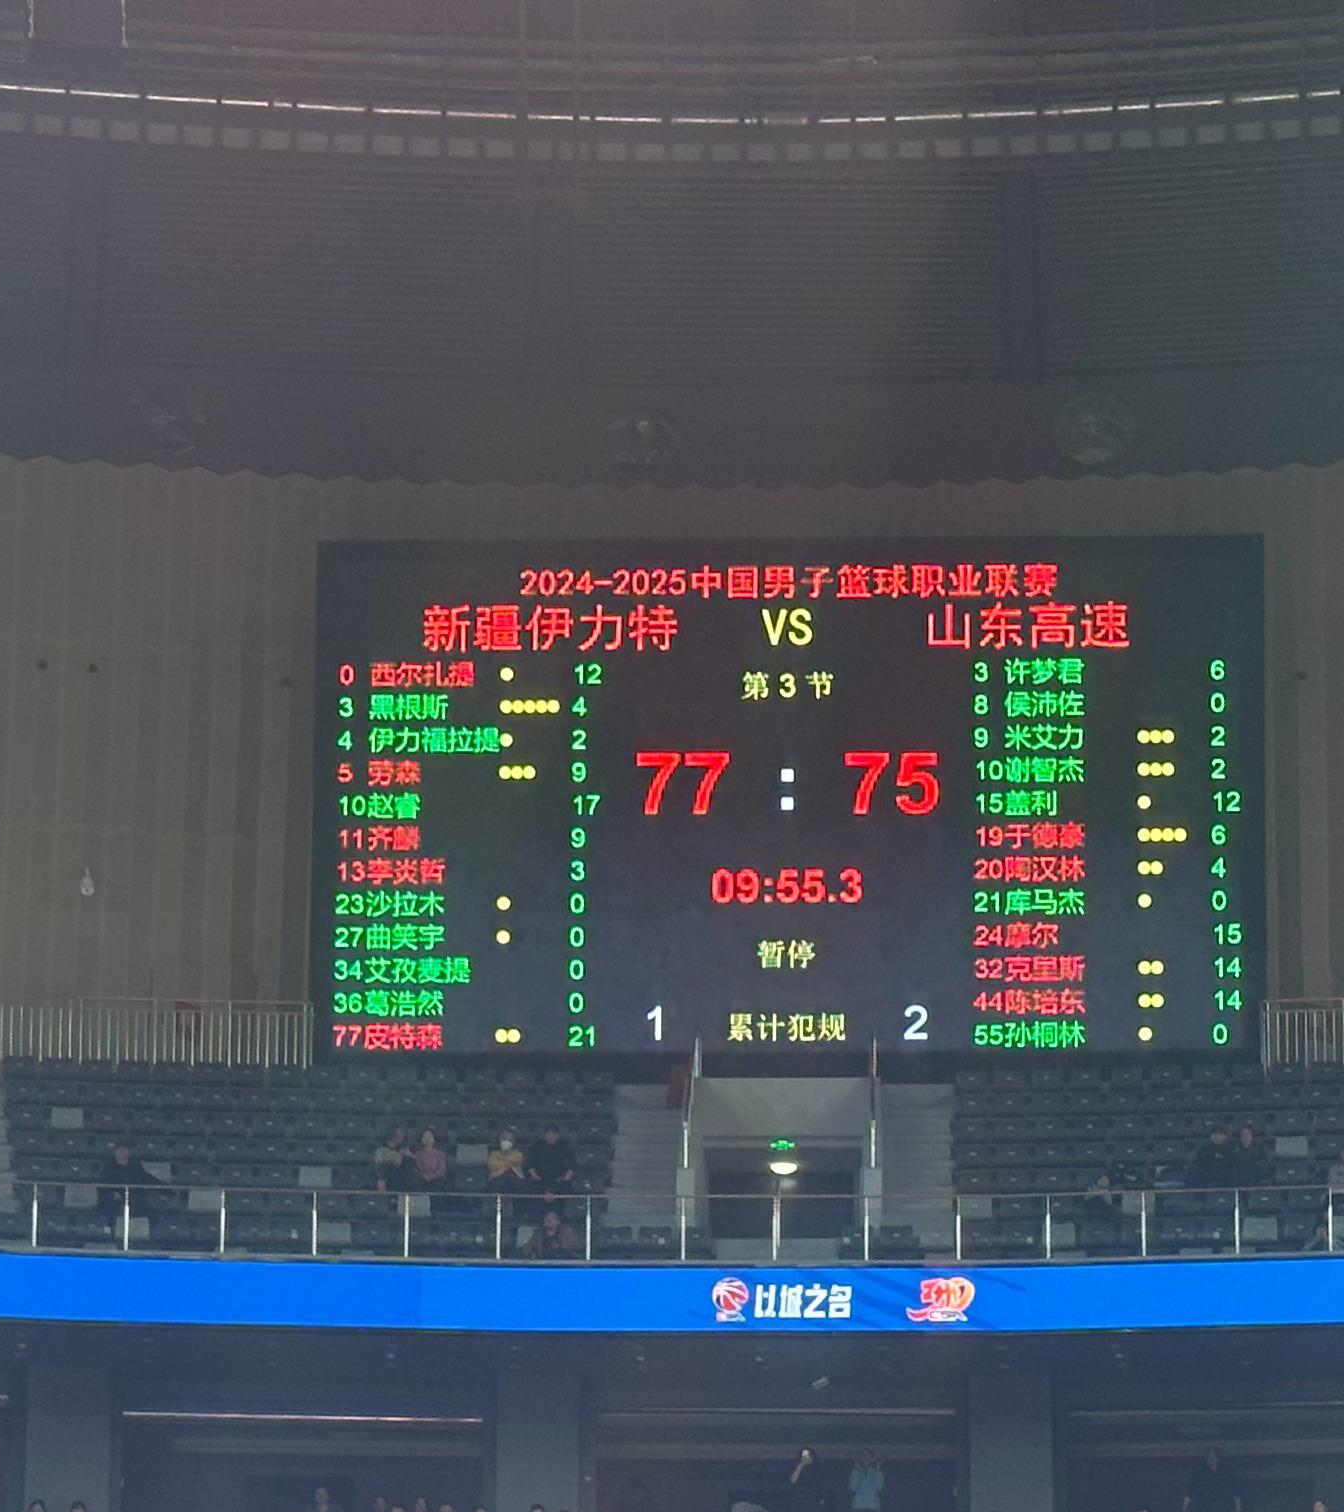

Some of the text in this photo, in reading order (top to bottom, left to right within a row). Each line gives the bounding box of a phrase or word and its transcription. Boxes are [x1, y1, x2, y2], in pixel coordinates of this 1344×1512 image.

[519, 564, 1058, 600] 2024-2025中国男子篮球职业联赛
[422, 601, 1131, 653] 新疆伊力特 VS 山东高速
[339, 664, 354, 686] 0
[574, 664, 602, 685] 12
[974, 658, 1225, 685] 3 许梦君 6
[741, 671, 834, 701] 第 3 节
[339, 694, 587, 720] 3 黑根斯 4
[974, 690, 1225, 717] 8 侯沛佐 0
[337, 730, 353, 750] 4
[572, 730, 587, 750] 2
[974, 723, 1225, 750] 9 米艾力 2
[337, 759, 587, 786] 5 劳森 9
[1211, 758, 1226, 779] 2
[635, 751, 731, 815] 77
[843, 751, 941, 816] 75
[573, 795, 601, 816] 17
[1213, 791, 1241, 812] 12
[570, 828, 586, 848] 9
[1211, 824, 1226, 845] 6
[570, 861, 585, 881] 3
[1211, 857, 1226, 878] 4
[711, 867, 863, 905] 09:55.3
[570, 894, 585, 914] 0
[1212, 890, 1227, 911] 0
[570, 927, 585, 947] 0
[1214, 924, 1242, 945] 15
[756, 939, 816, 969] 暂停
[569, 960, 584, 980] 0
[1214, 957, 1242, 978] 14
[569, 993, 584, 1013] 0
[1214, 990, 1242, 1011] 14
[646, 1005, 928, 1043] 1 累计犯规 2
[1213, 1023, 1228, 1045] 0
[568, 1026, 595, 1047] 21
[754, 1284, 852, 1319] 以城之名
